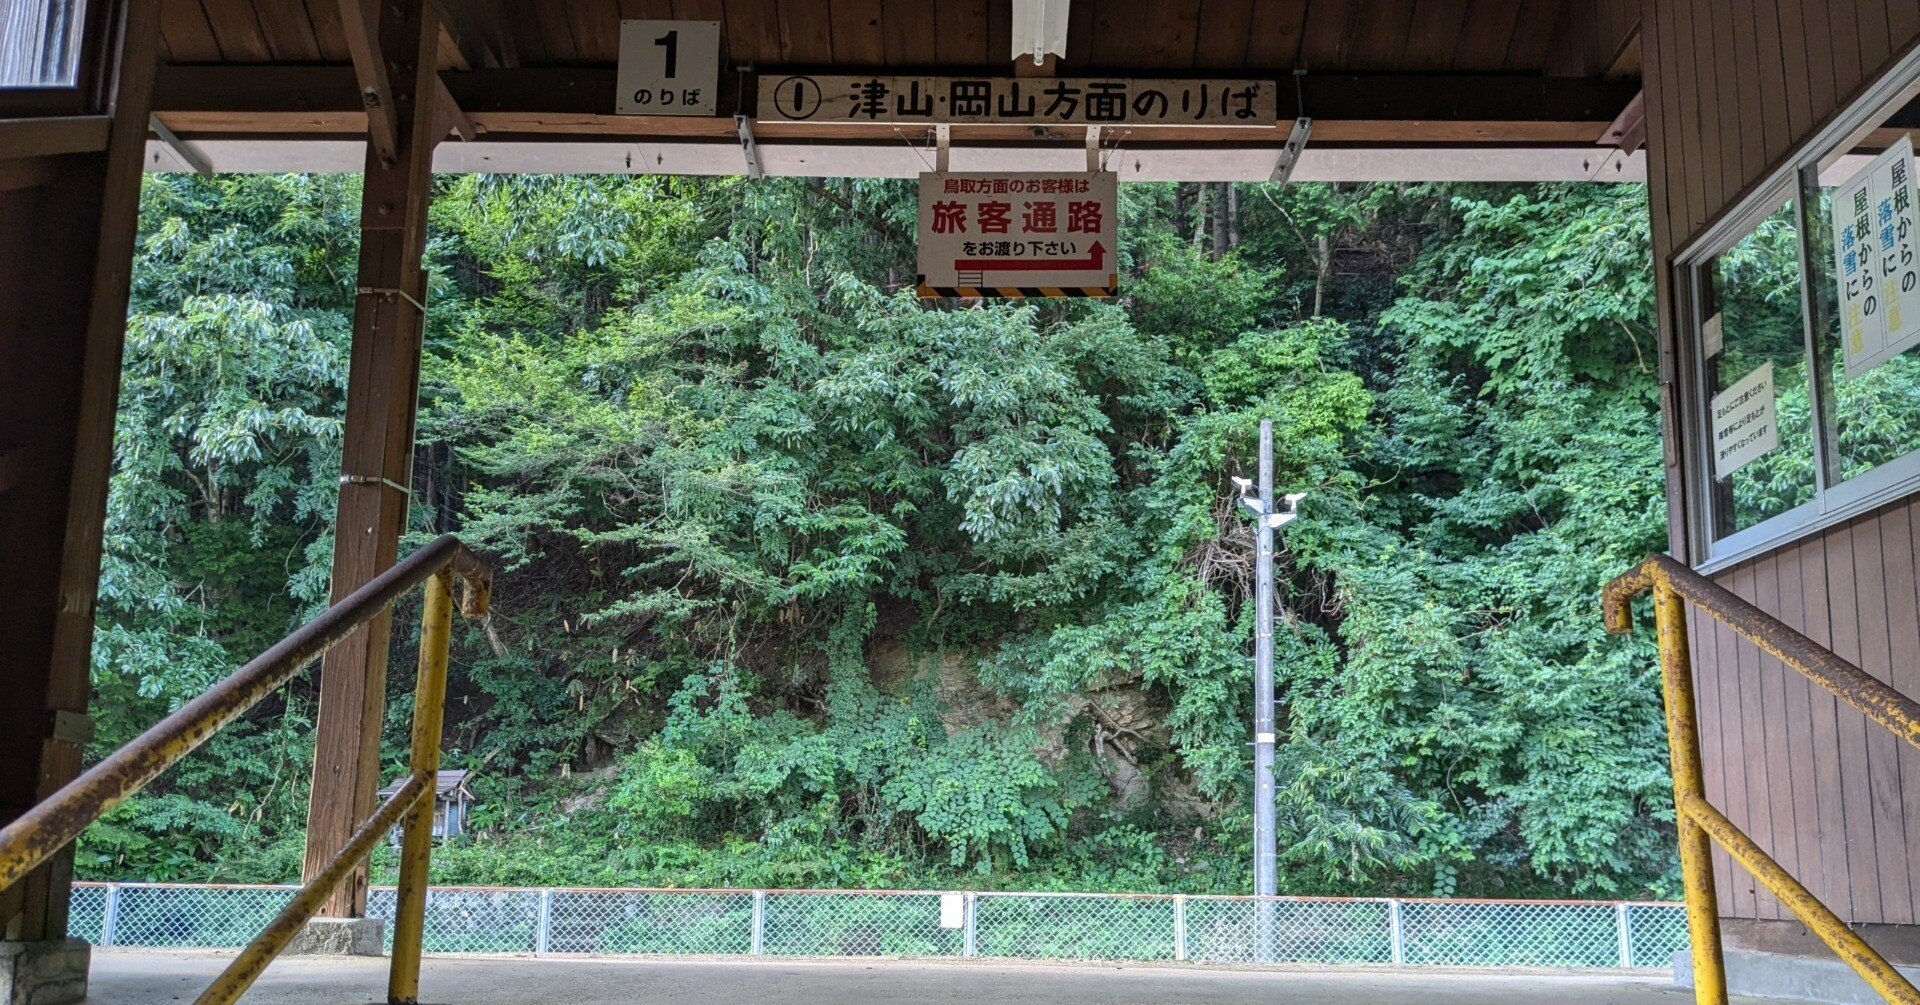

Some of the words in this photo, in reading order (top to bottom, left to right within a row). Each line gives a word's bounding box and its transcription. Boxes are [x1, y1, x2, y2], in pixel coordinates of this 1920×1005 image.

[653, 30, 678, 79] 1
[633, 88, 701, 107] のりば
[944, 178, 1090, 195] 鳥取方面のお客様は
[931, 200, 1103, 234] 旅客通路
[1891, 157, 1916, 292] 屋根からの
[962, 241, 1076, 256] をお渡り下さい
[1854, 186, 1877, 317] 屋根からの
[1877, 197, 1902, 333] 落雪に注意
[1841, 224, 1863, 355] 落雪に注意
